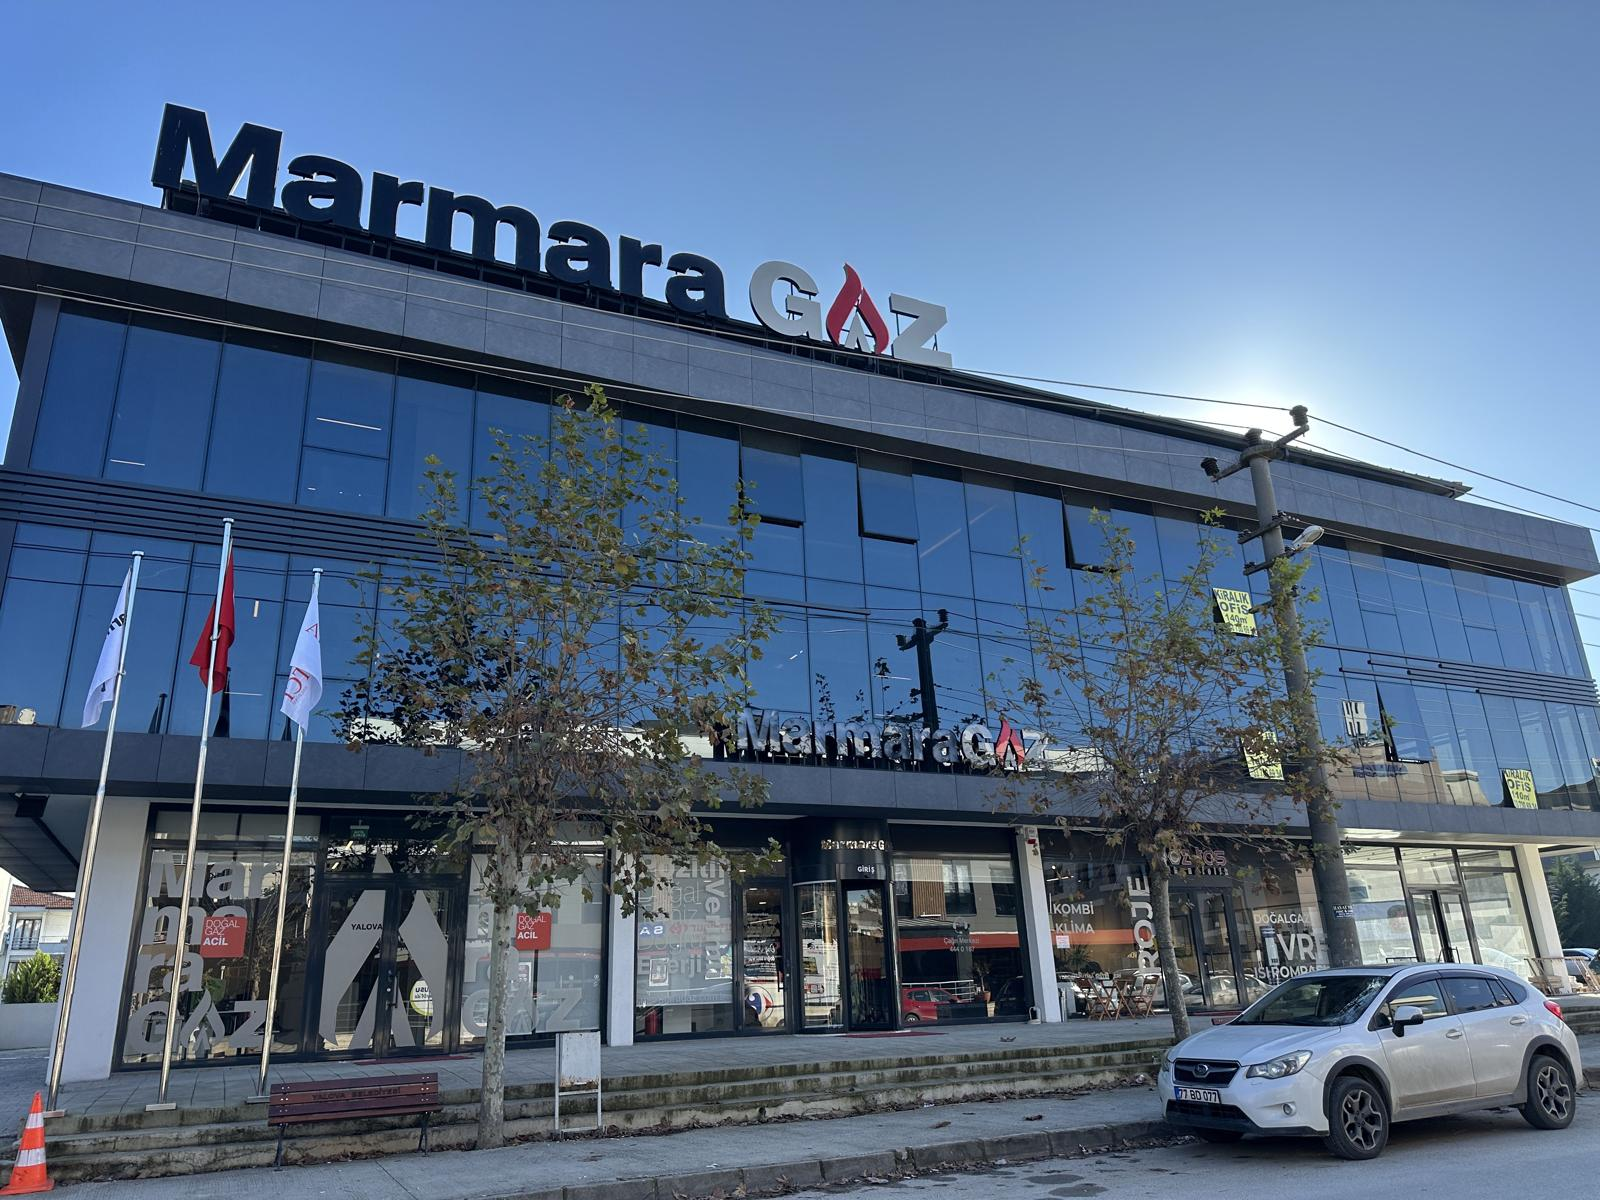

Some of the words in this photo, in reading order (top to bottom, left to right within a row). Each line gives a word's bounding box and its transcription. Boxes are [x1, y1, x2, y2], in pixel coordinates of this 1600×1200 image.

[151, 101, 727, 319] Marmara
[1220, 601, 1249, 615] OFİS
[1507, 779, 1532, 792] OFİS
[857, 864, 875, 874] GİRİŞ
[1053, 901, 1094, 915] KOMBİ
[205, 918, 240, 928] DOĞAL
[351, 923, 383, 931] YALOVA
[1056, 920, 1095, 934] KLİMA
[204, 927, 225, 936] GAZ
[517, 930, 538, 939] ACİL
[203, 935, 229, 946] ACİL
[1179, 1088, 1188, 1099] 77
[1190, 1089, 1202, 1101] BD
[1203, 1090, 1217, 1102] 077
